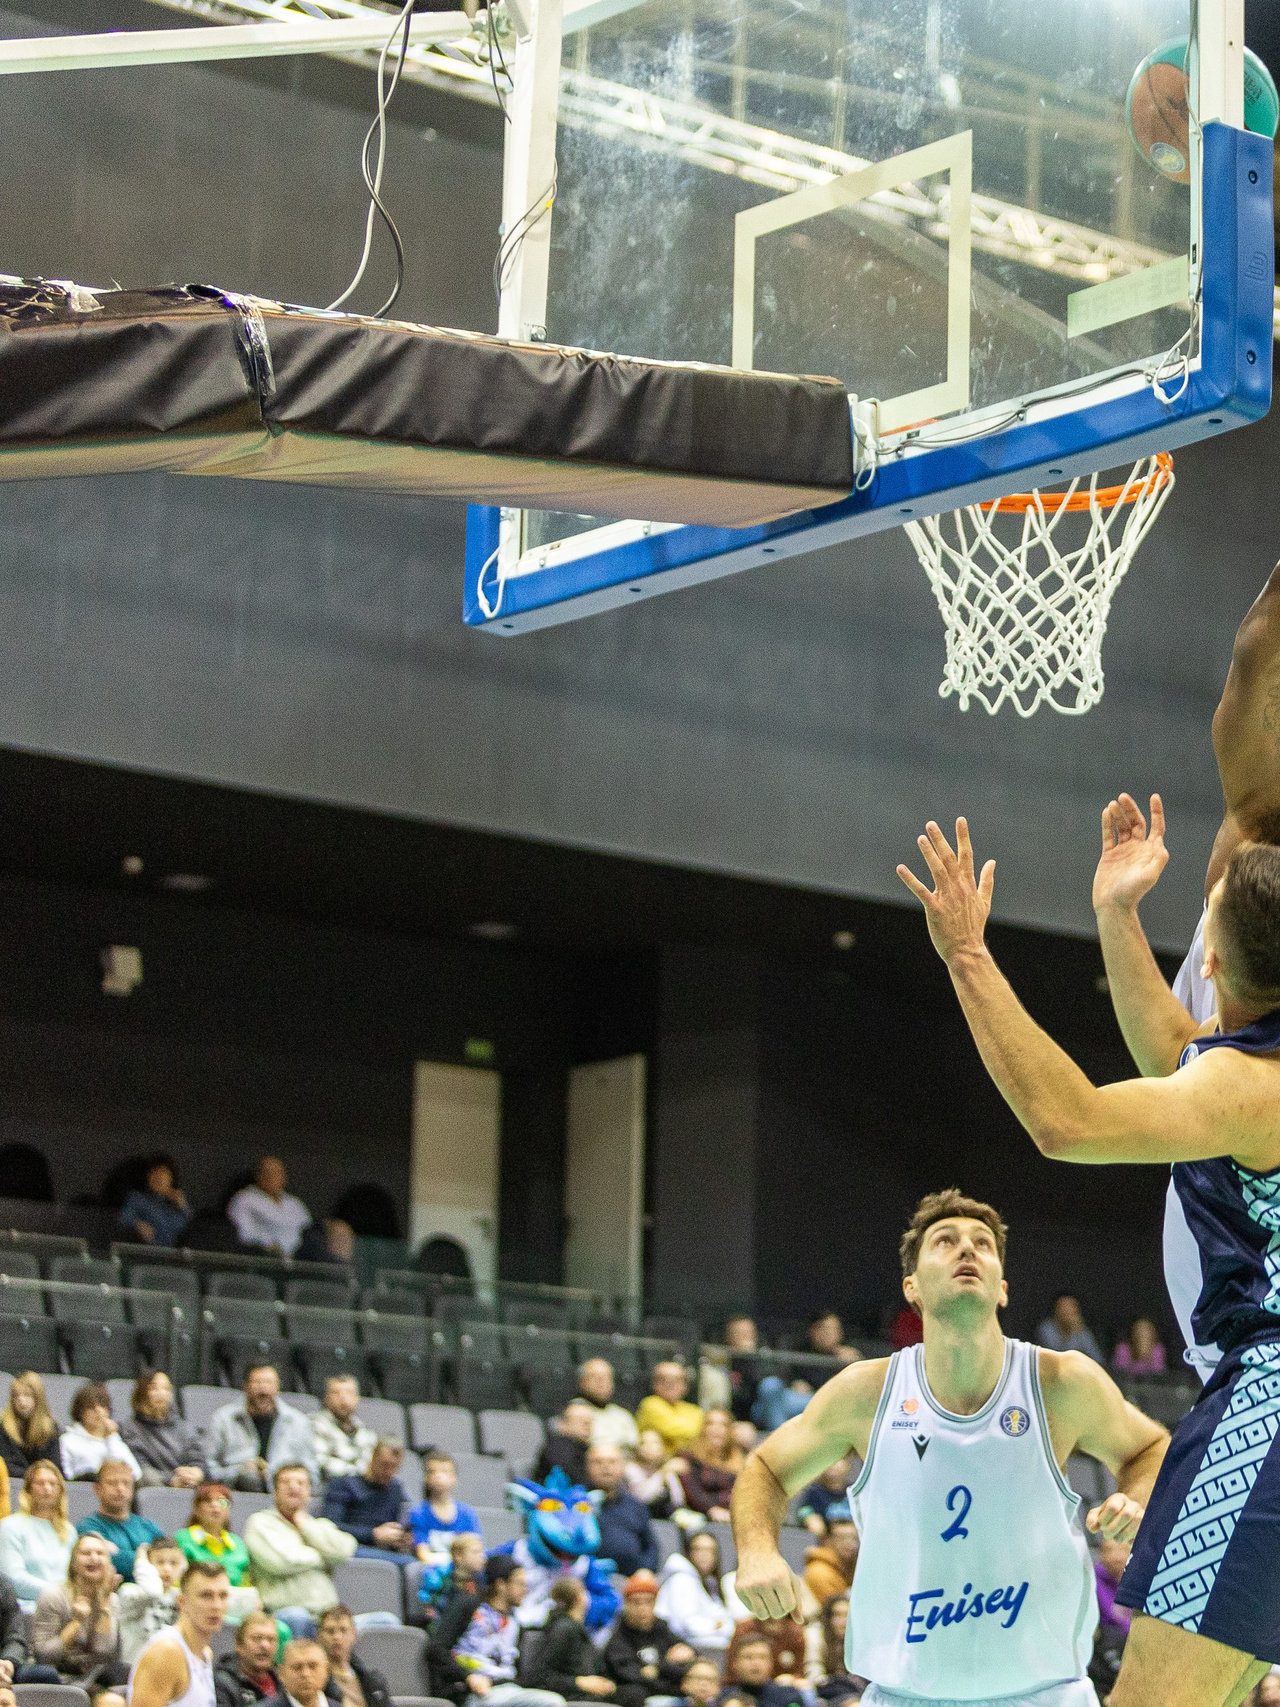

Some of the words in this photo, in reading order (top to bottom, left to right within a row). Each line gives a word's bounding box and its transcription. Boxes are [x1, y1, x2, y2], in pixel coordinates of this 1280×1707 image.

[891, 1420, 919, 1428] ENISEY
[941, 1485, 972, 1542] 2
[906, 1581, 1029, 1643] Enisey
